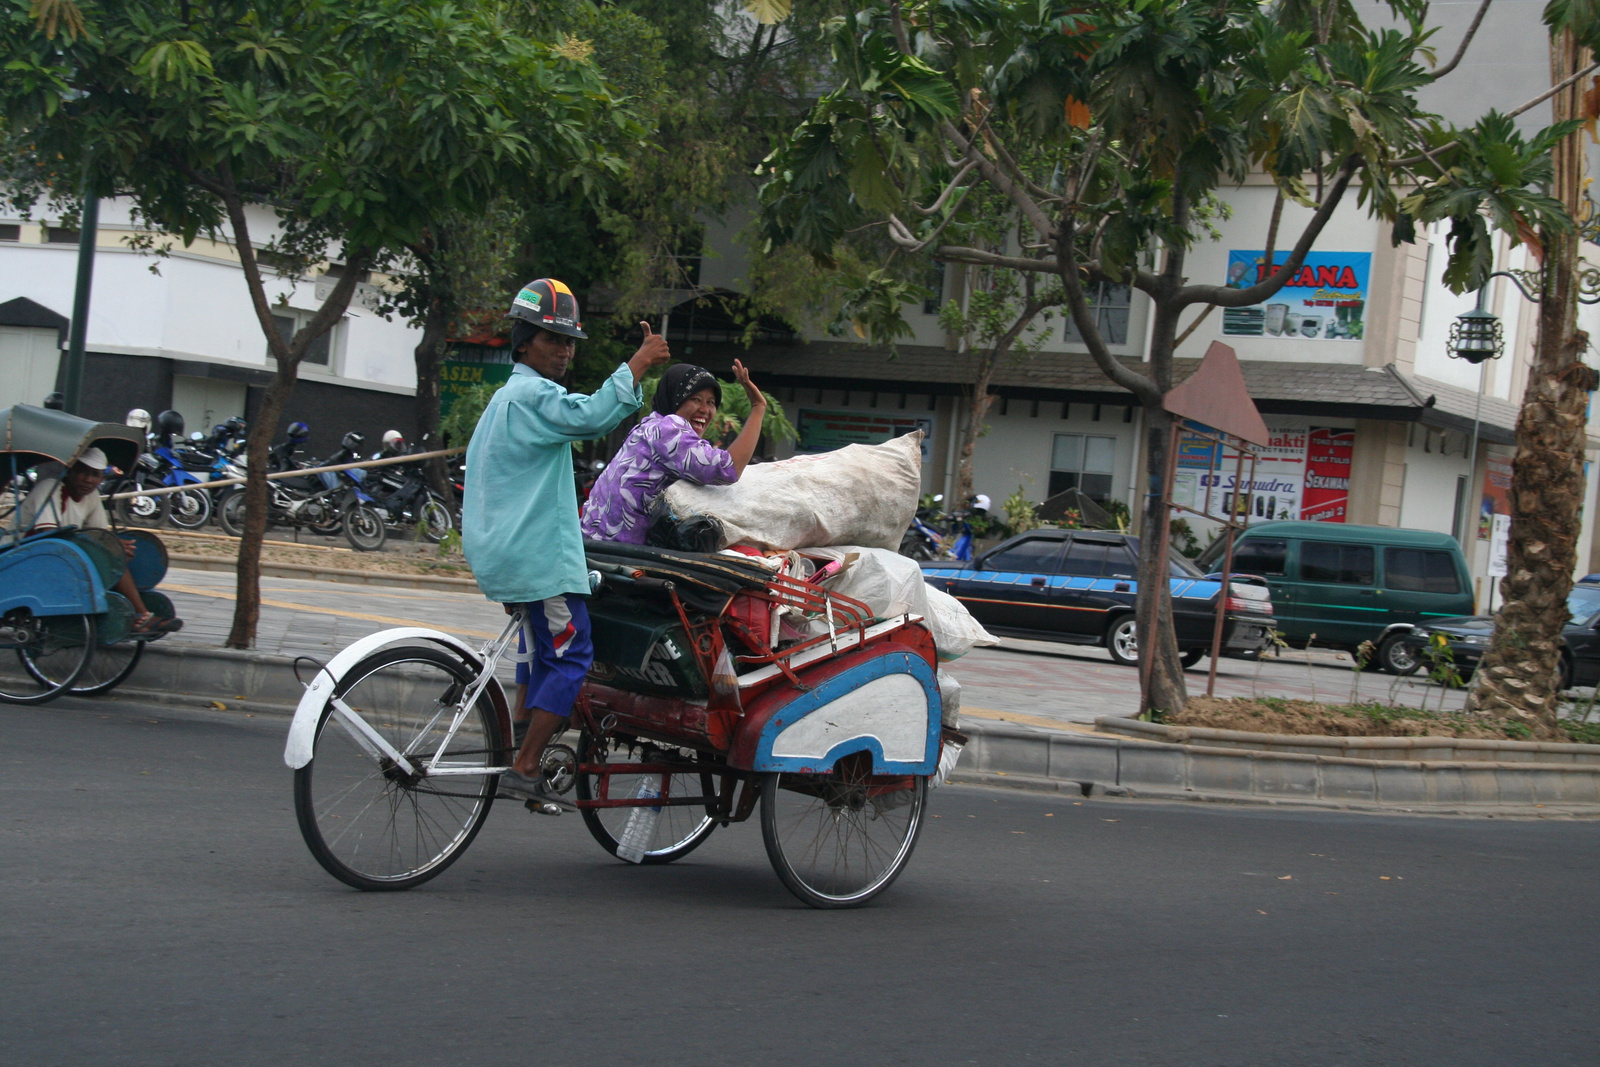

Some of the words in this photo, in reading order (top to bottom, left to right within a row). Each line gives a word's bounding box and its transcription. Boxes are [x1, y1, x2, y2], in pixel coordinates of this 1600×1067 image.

[1257, 264, 1359, 288] IANA
[1251, 446, 1305, 454] ELECTRONIC
[1337, 506, 1344, 516] 2
